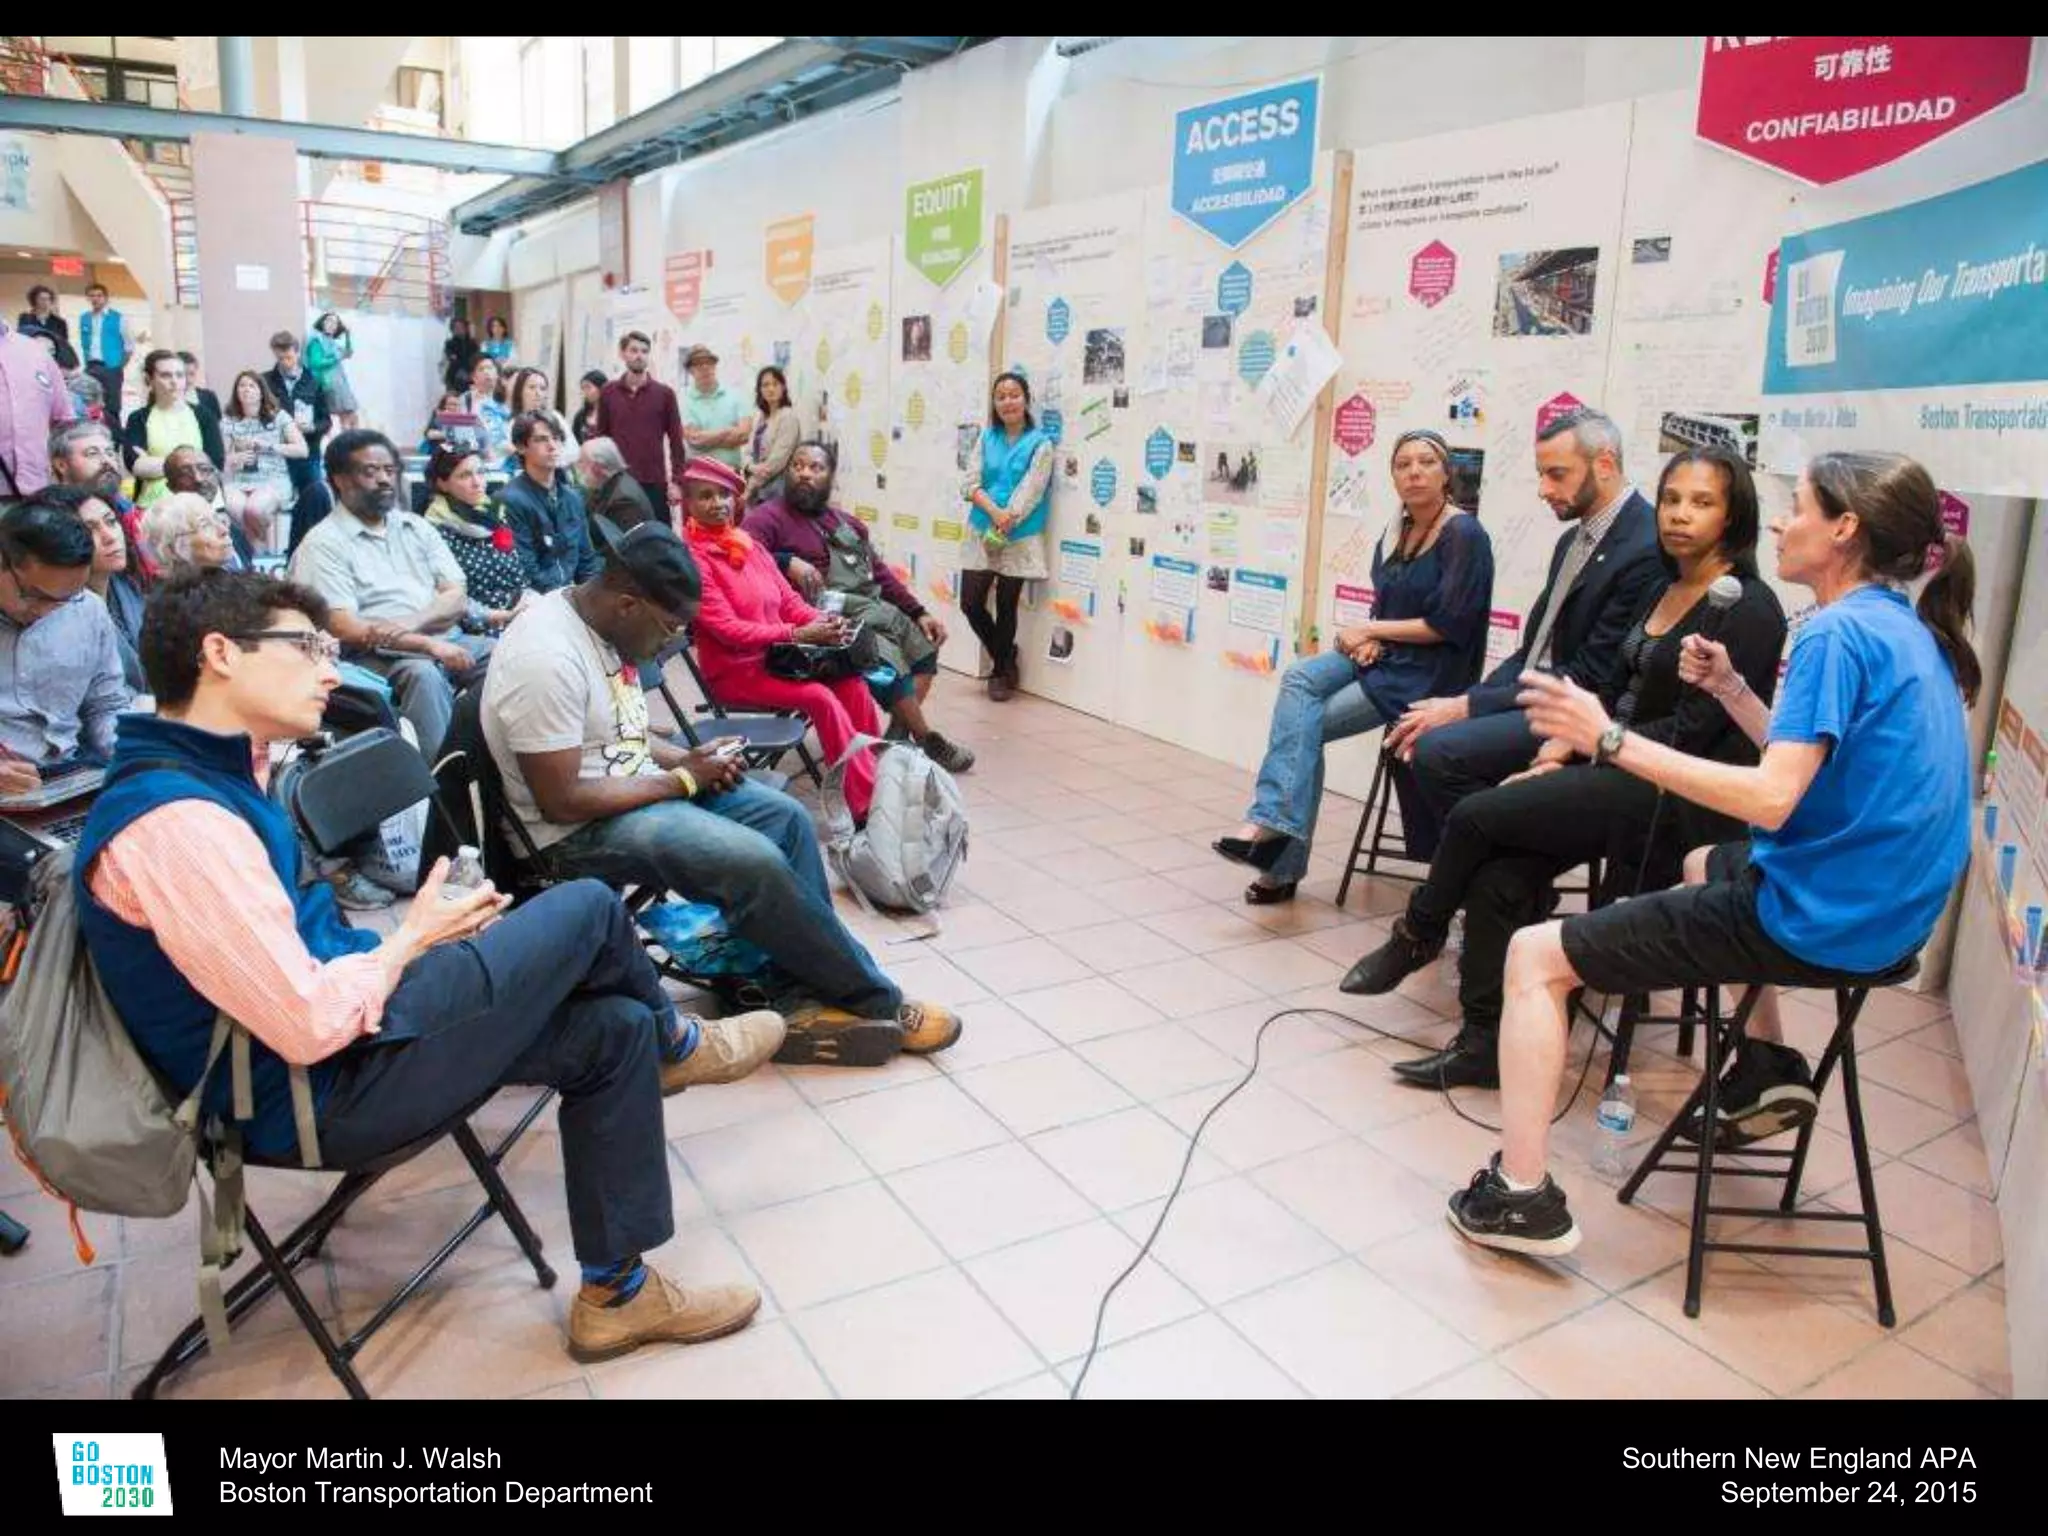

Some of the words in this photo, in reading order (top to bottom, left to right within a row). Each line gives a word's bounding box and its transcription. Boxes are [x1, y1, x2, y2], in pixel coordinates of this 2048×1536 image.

[1814, 44, 1892, 82] 可靠性
[1185, 98, 1300, 155] ACCESS
[1746, 96, 1956, 143] CONFIABILIDAD
[913, 181, 972, 217] EQUITY
[1842, 276, 1917, 321] Imagining
